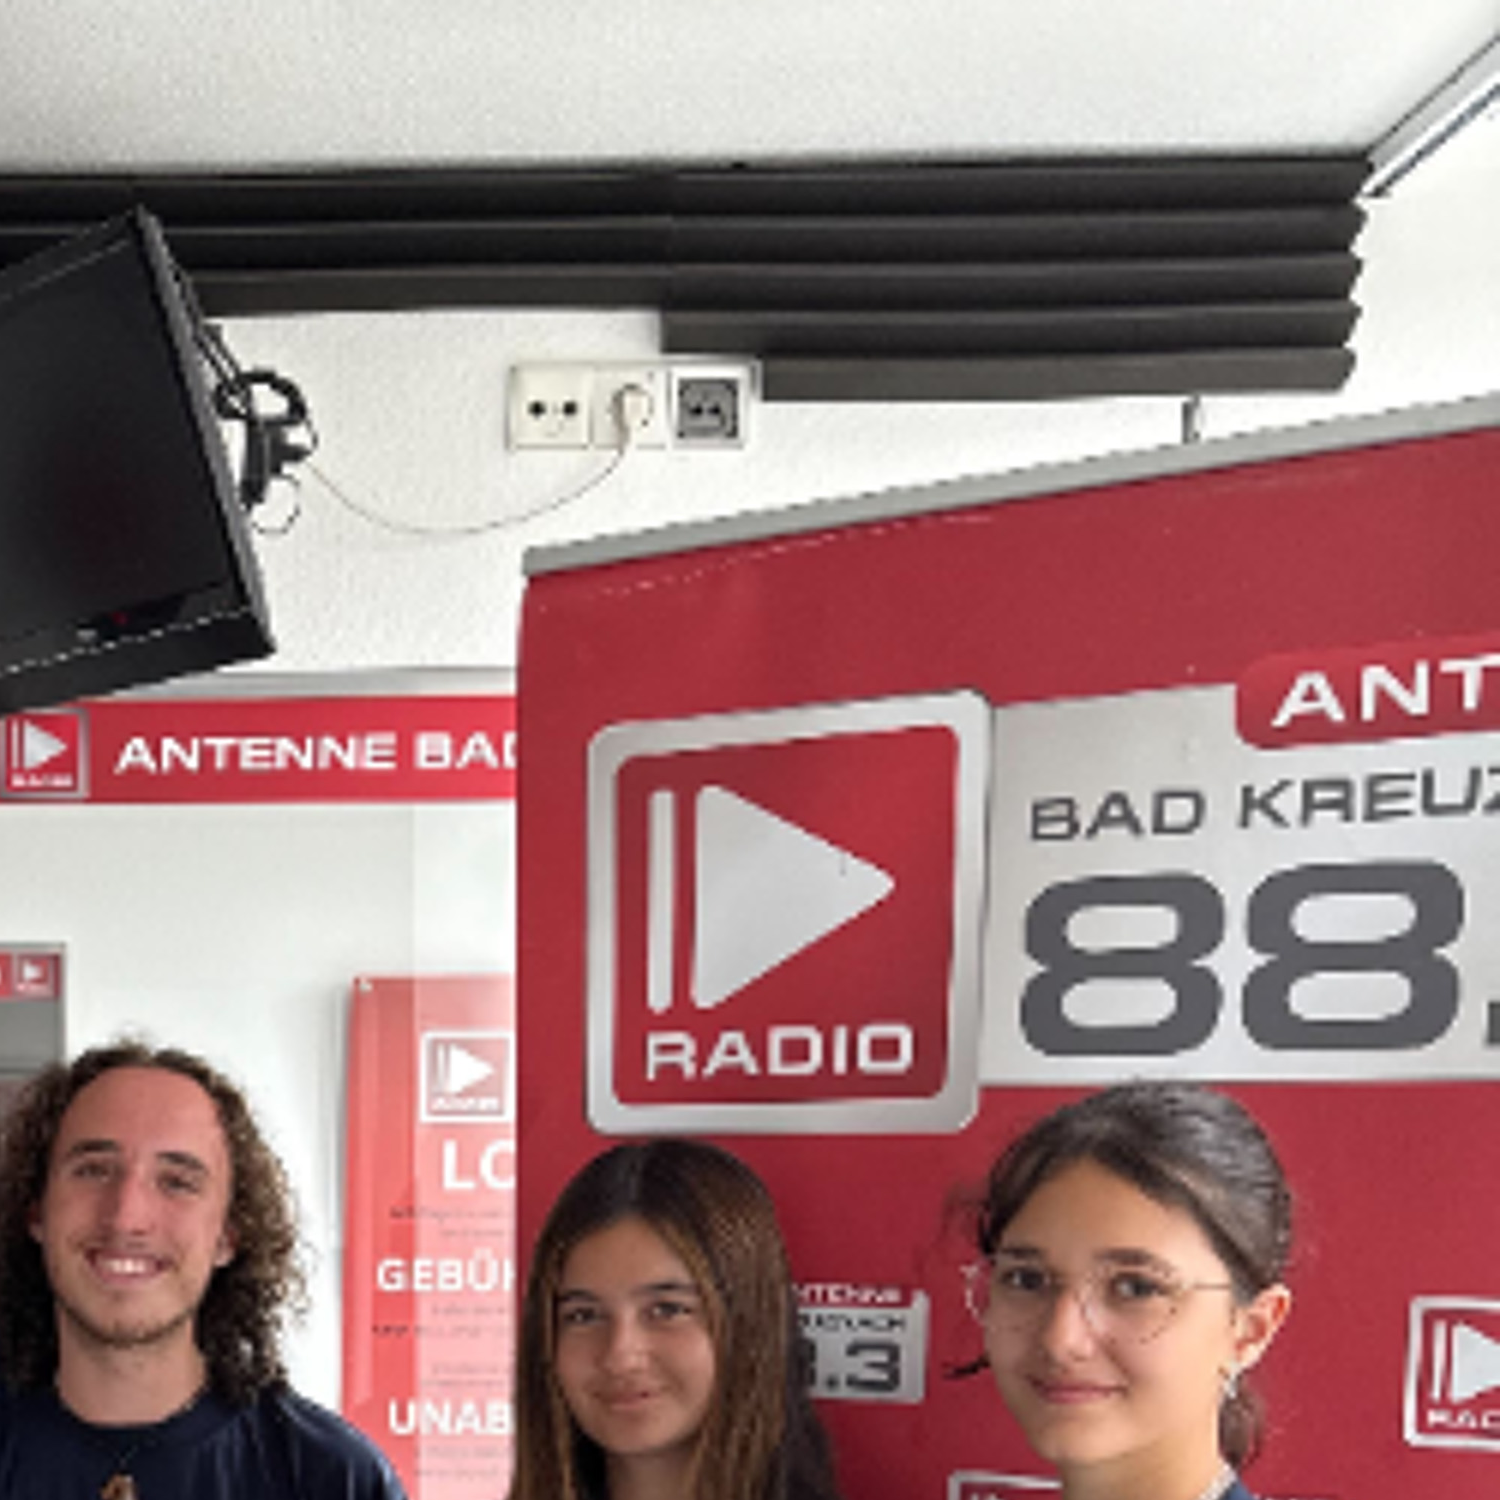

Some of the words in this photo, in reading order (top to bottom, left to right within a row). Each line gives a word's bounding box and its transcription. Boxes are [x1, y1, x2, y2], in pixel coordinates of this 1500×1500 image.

[1270, 653, 1500, 728] ANT
[114, 734, 398, 775] ANTENNE
[1029, 789, 1206, 841] BAD
[1236, 766, 1500, 830] KREU
[1019, 858, 1500, 1056] 88
[645, 1024, 914, 1081] RADIO
